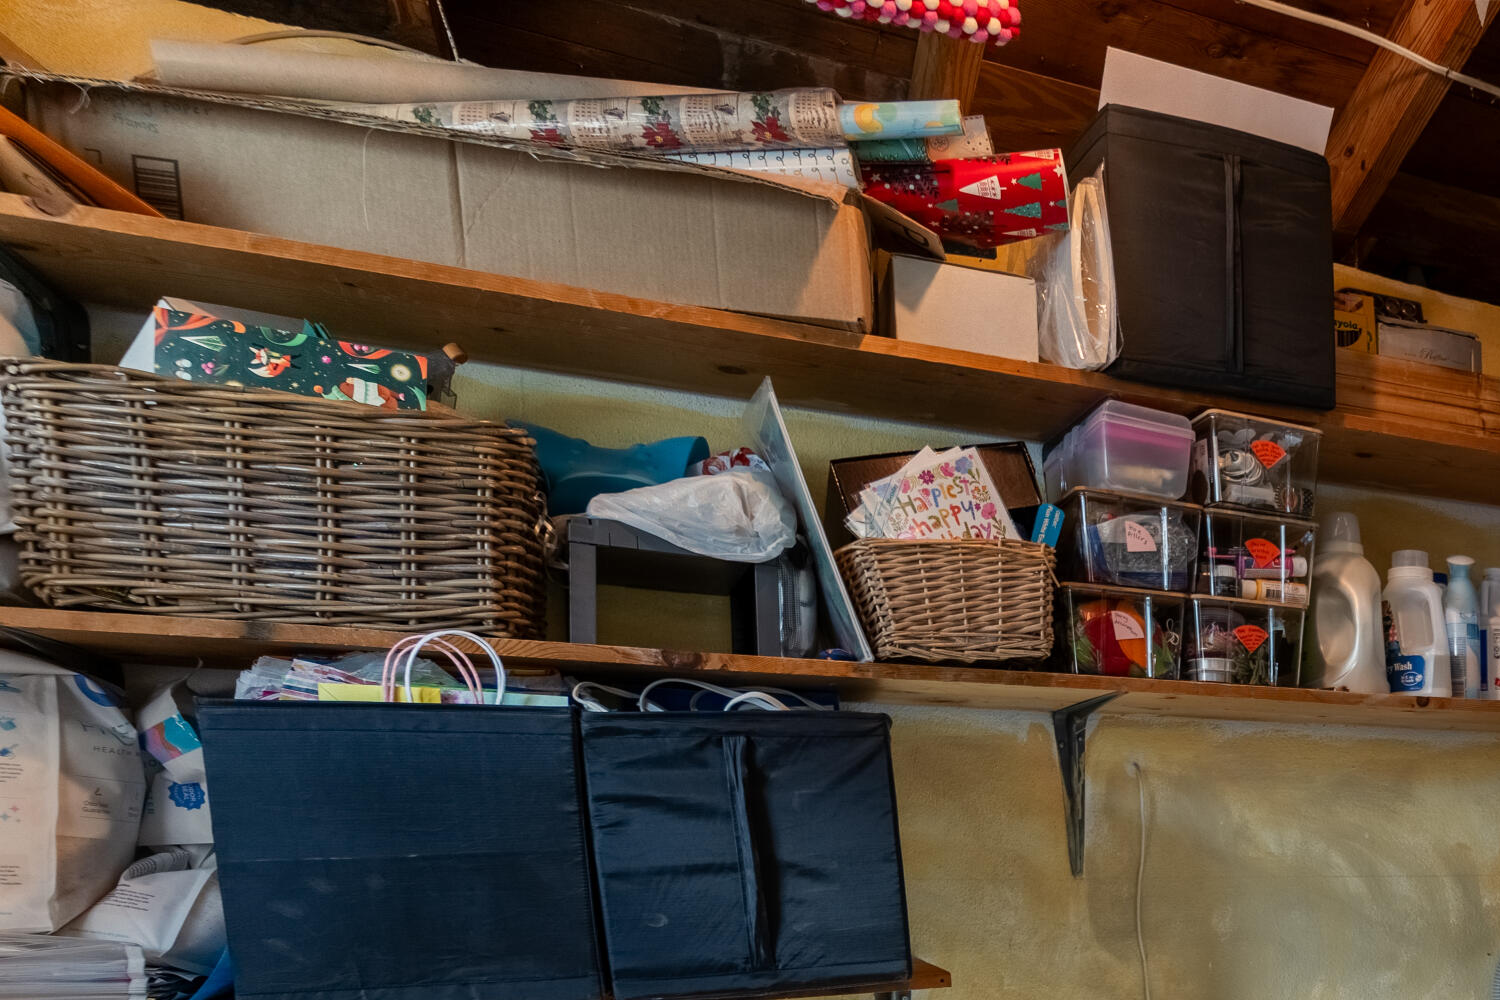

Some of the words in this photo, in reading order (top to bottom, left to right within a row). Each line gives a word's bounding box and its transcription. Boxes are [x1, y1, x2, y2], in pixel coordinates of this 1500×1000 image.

[897, 475, 971, 517] Happiest
[911, 500, 977, 537] happy
[1393, 661, 1413, 672] Wash
